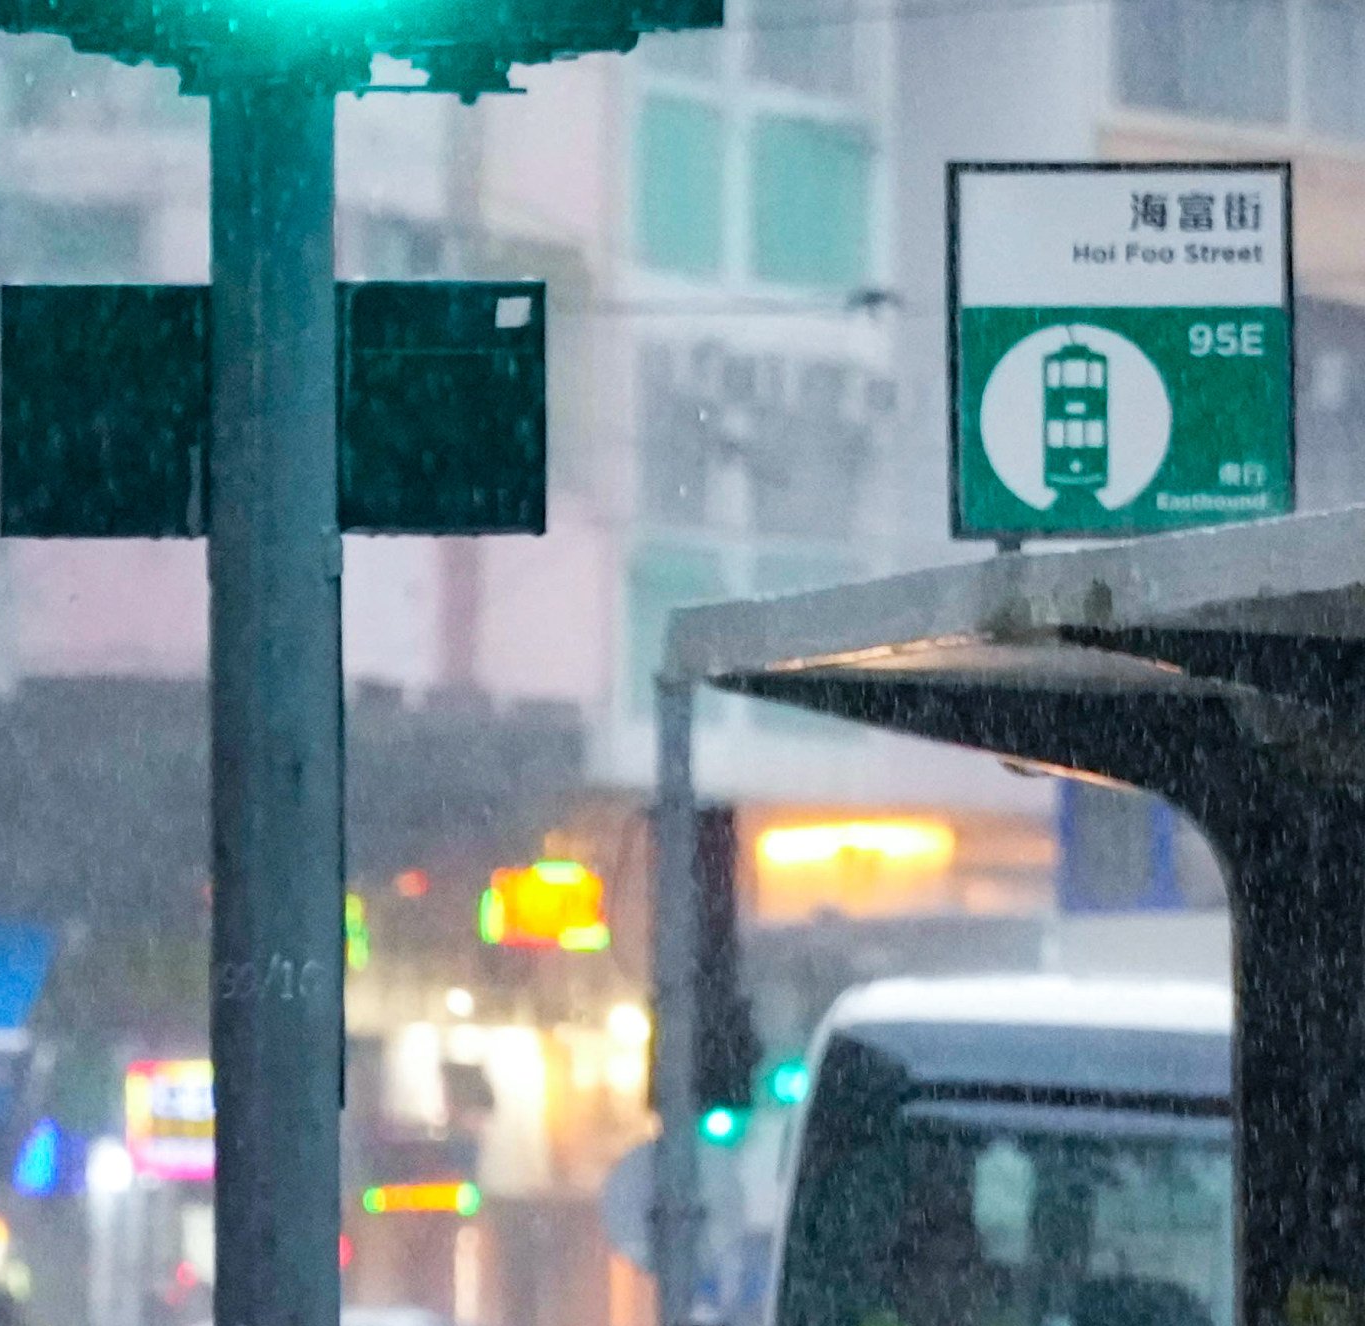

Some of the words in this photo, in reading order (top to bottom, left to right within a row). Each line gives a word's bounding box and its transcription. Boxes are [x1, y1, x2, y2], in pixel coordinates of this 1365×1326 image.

[1130, 191, 1260, 232] 海富街
[1183, 243, 1263, 265] Street
[1187, 322, 1265, 358] 95E
